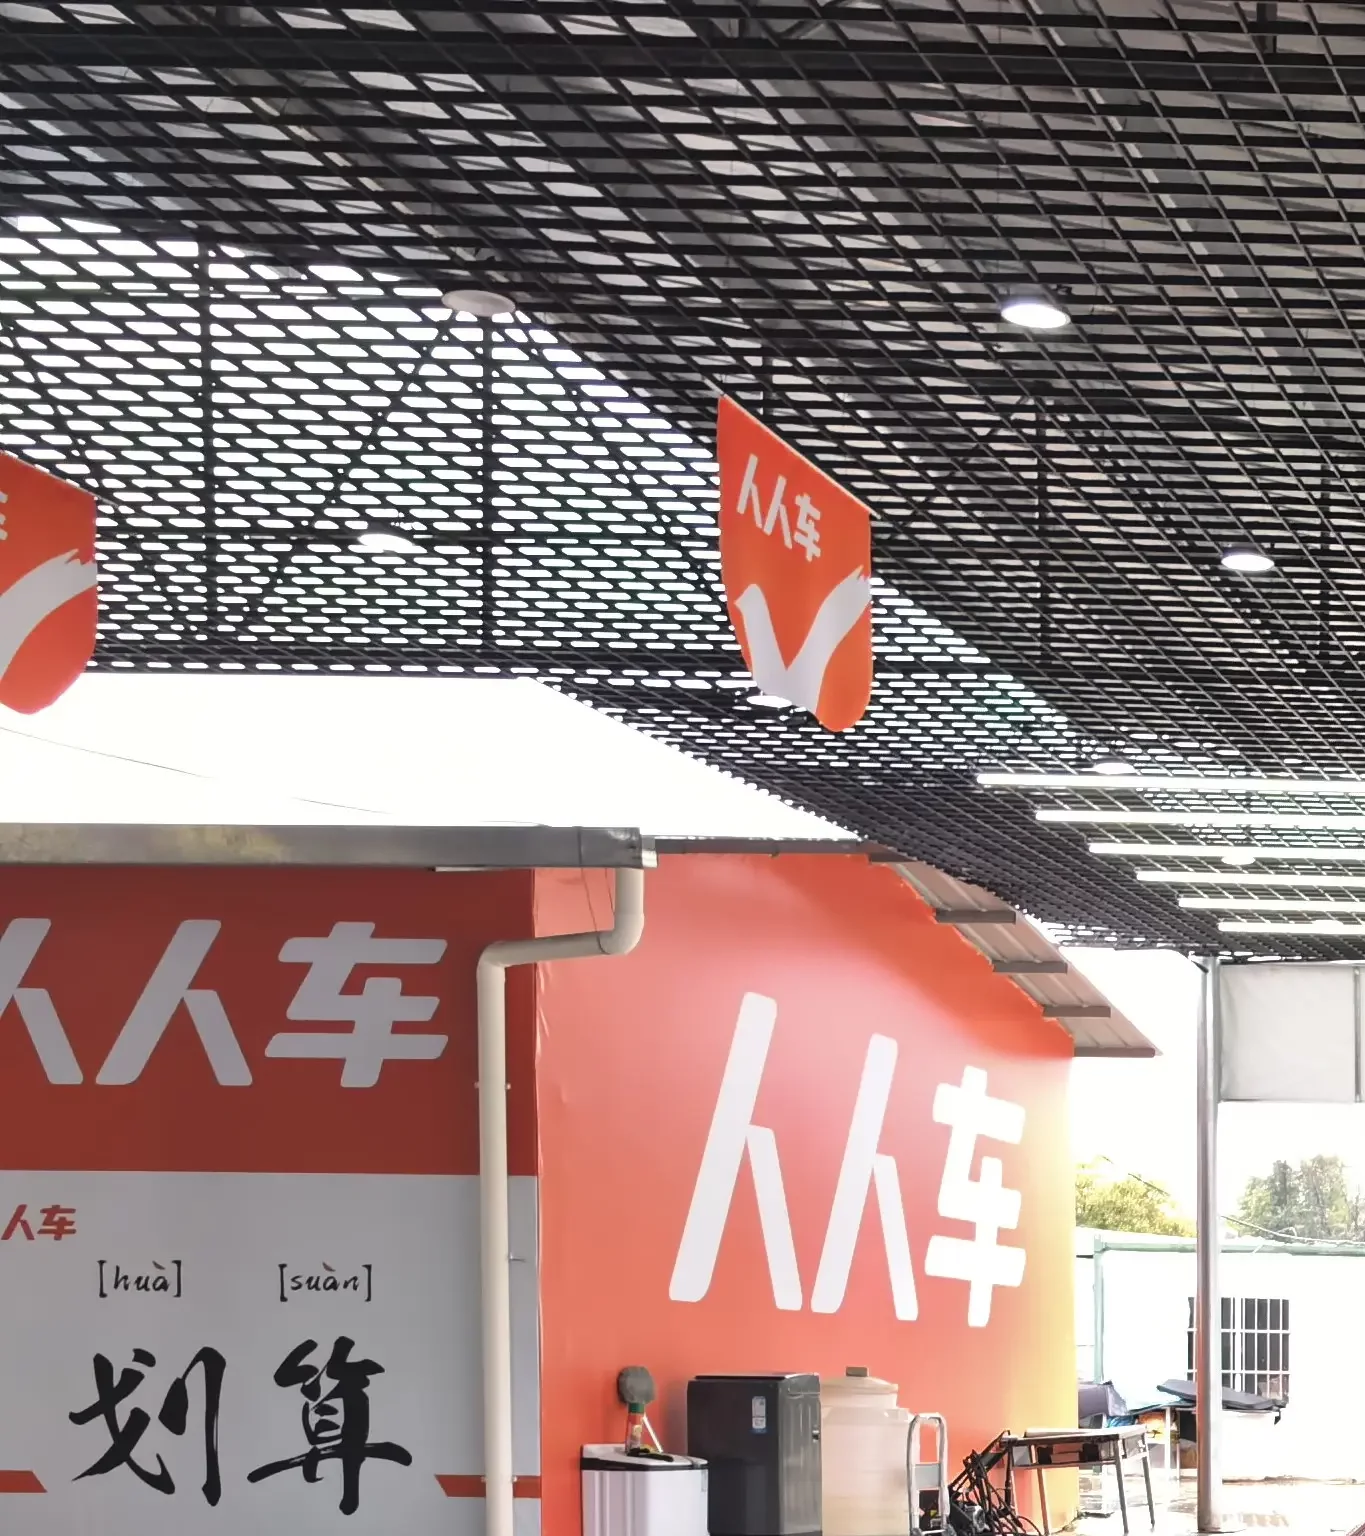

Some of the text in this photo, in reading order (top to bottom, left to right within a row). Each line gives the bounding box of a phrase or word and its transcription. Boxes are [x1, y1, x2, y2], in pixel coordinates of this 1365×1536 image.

[736, 452, 821, 562] 人人车
[669, 991, 1027, 1328] 人人车
[68, 1336, 413, 1516] 划算
